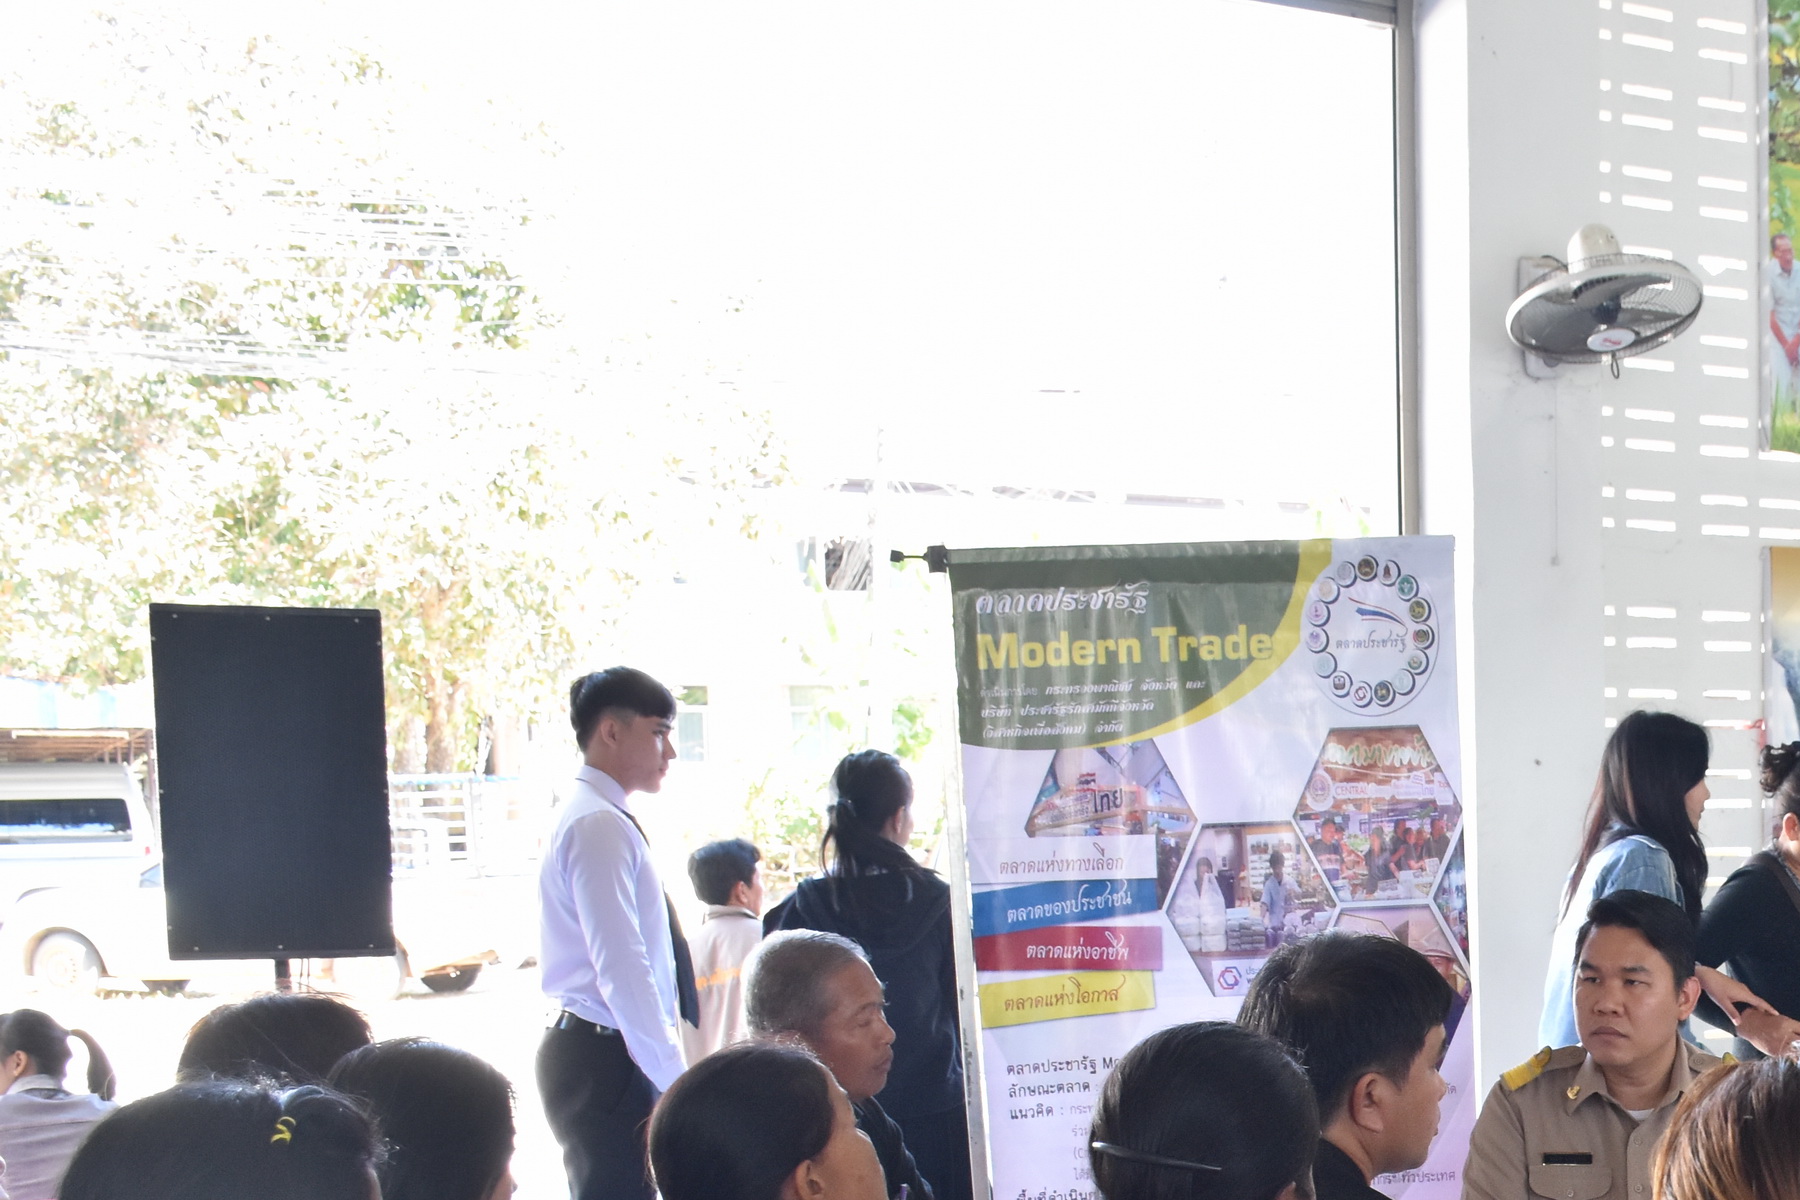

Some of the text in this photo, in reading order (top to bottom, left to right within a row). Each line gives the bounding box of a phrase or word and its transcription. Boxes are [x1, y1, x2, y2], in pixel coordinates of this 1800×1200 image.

[976, 584, 1148, 615] ตลาดประชารัฐ
[977, 625, 1274, 671] Modern Trade
[1335, 627, 1408, 653] ตลาดประชารัฐ
[1000, 843, 1125, 875] ตลาดแห่งทางเลือก
[1007, 881, 1133, 922] ตลาดของประชาชน
[1026, 931, 1129, 961] ตลาดแห่งอาชีพ
[1003, 974, 1126, 1010] ตลาดแห่งโอกาส
[1007, 1056, 1096, 1075] ตลาดประชารัฐ
[1008, 1081, 1090, 1098] ลักษณะตลาด
[1010, 1103, 1054, 1120] แนวคิด
